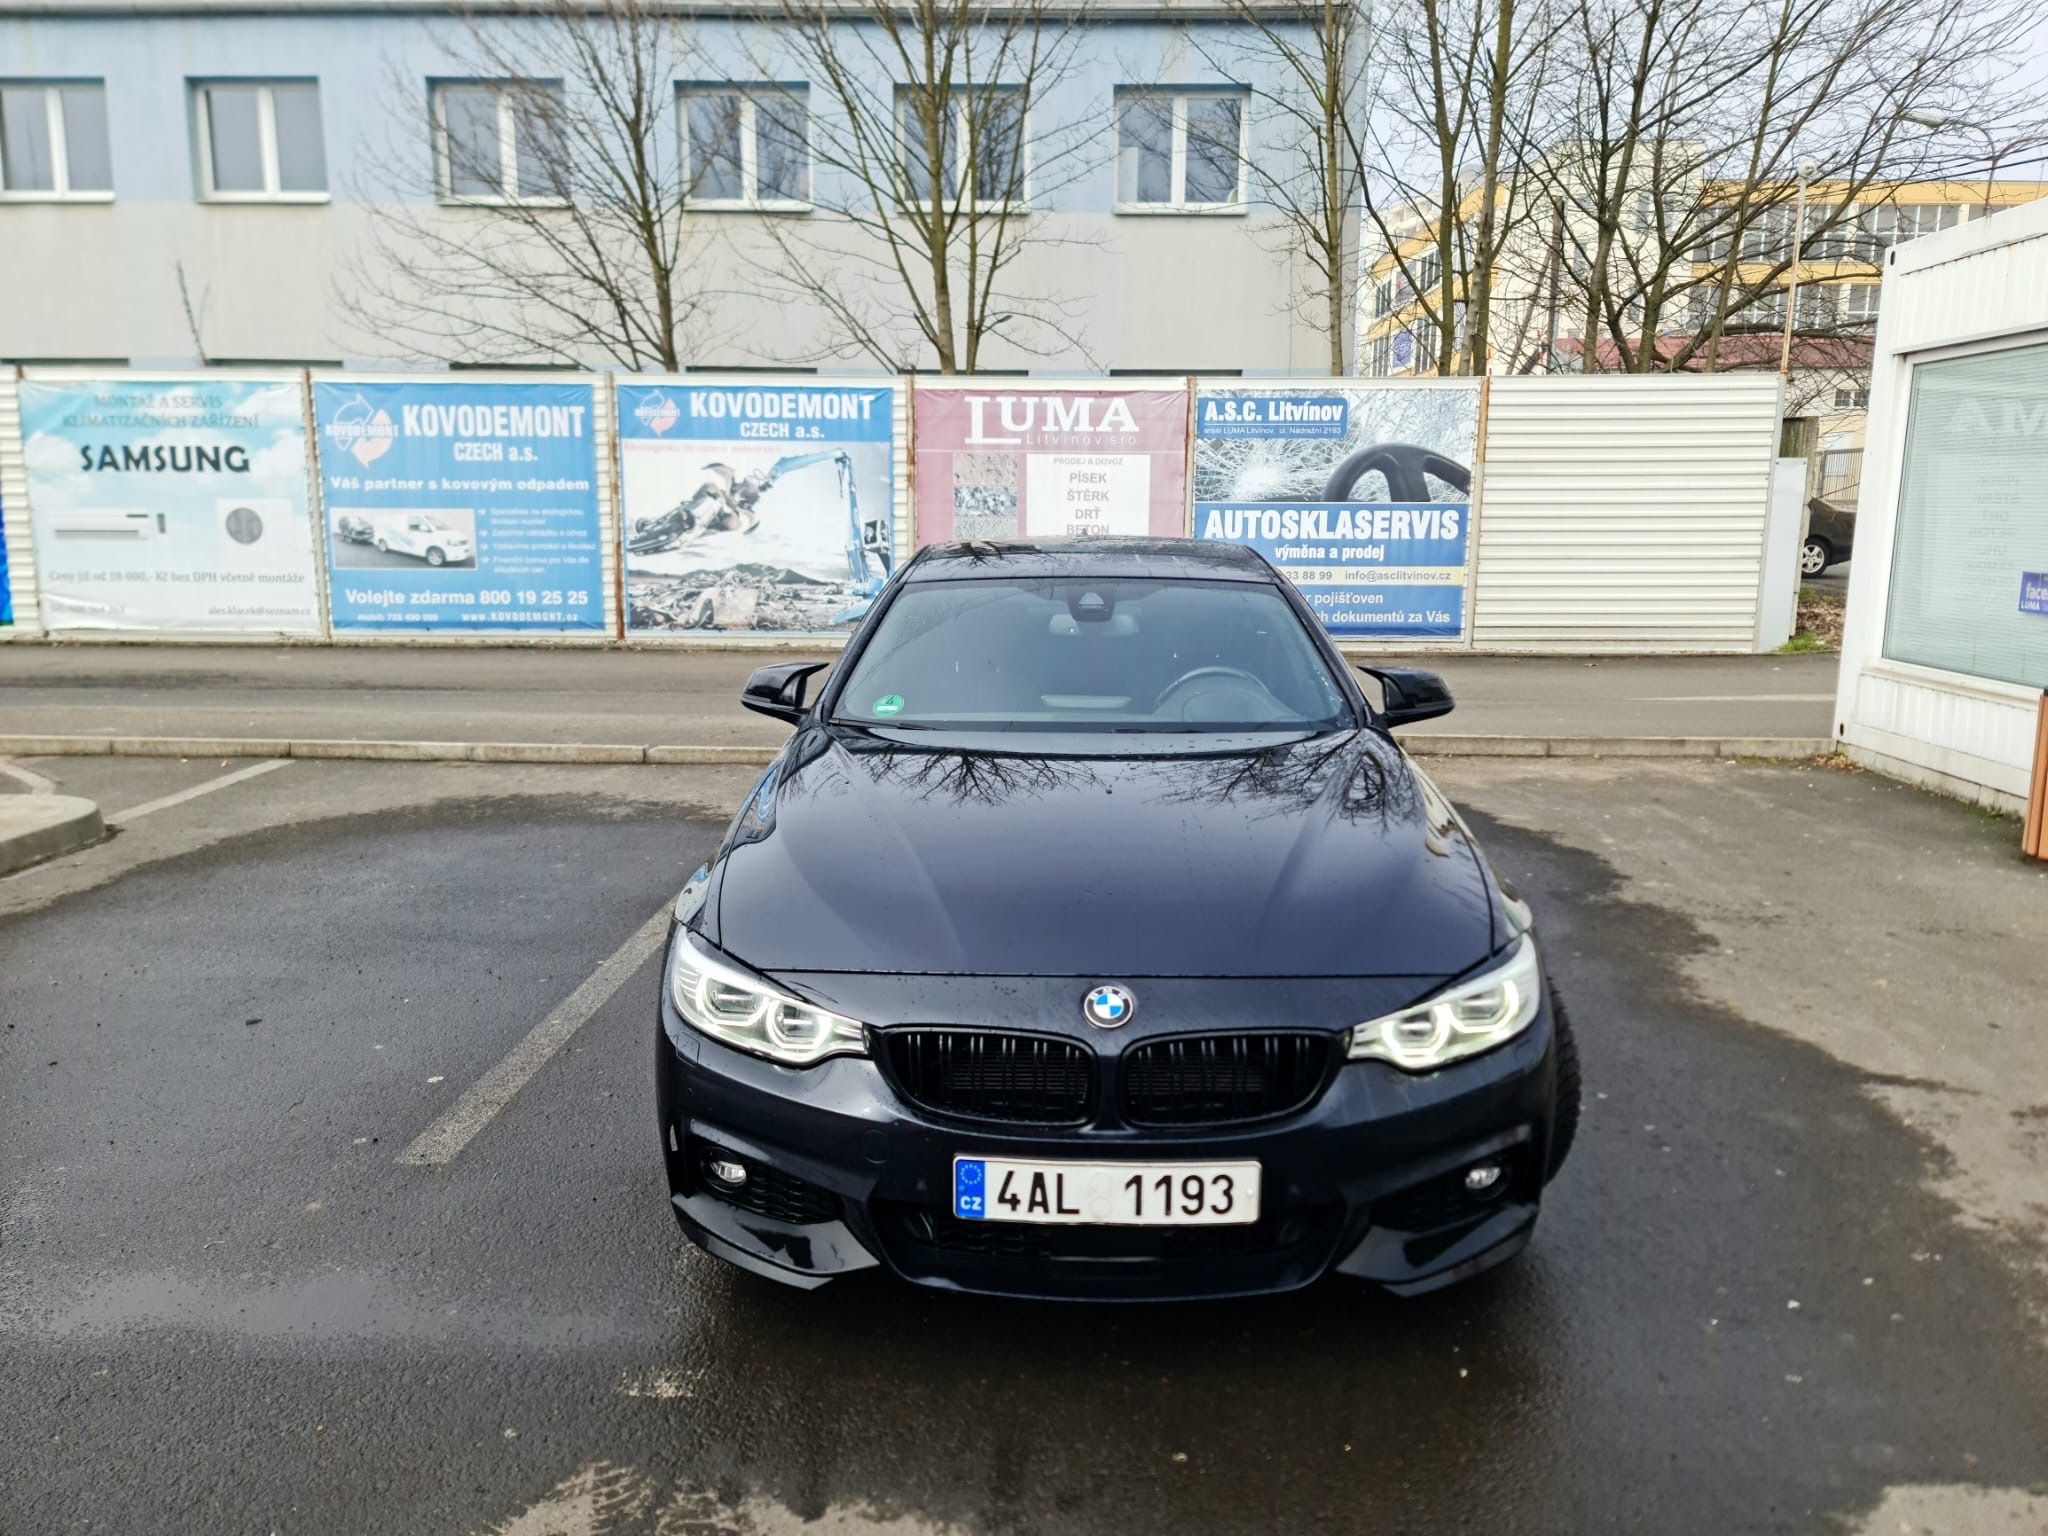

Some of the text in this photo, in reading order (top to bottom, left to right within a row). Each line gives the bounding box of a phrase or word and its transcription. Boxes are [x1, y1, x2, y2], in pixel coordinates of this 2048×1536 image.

[94, 392, 223, 408] MONTÁŽ A SERVIS
[690, 392, 875, 420] KOVODEMONT
[1204, 400, 1343, 422] A.S.C. Litvínov
[402, 405, 585, 438] KOVODEMONT
[964, 396, 1140, 445] LUMA
[740, 422, 825, 438] CZECH a.s.
[80, 445, 251, 473] SAMSUNG
[454, 442, 538, 462] CZECH a.s.
[1053, 457, 1123, 466] PRODEJ A DOVOZ
[330, 476, 589, 493] Váš partner s kovovým odpadem
[1069, 470, 1107, 484] PÍSEK
[1066, 488, 1110, 502] ŠTĚRK
[1075, 506, 1102, 520] DRŤ
[1066, 524, 1110, 536] BETON
[1203, 509, 1460, 540] AUTOSKLASERVIS
[1275, 544, 1385, 562] výměna a prodej
[171, 571, 191, 582] bez
[192, 572, 217, 583] DPH
[220, 571, 255, 583] včetně
[258, 572, 305, 584] montáže
[1303, 571, 1316, 580] 88
[1319, 571, 1333, 580] 99
[1345, 570, 1451, 582] info@asclitvinov.cz
[345, 588, 588, 607] Volejte zdarma 800 19 25 25
[1314, 592, 1383, 606] pojišťoven
[461, 612, 579, 622] www.KOVODEMONT.cz
[1408, 613, 1423, 623] za
[1426, 610, 1451, 623] Vás
[997, 1170, 1235, 1217] 4AL 1193
[960, 1196, 982, 1211] CZ
